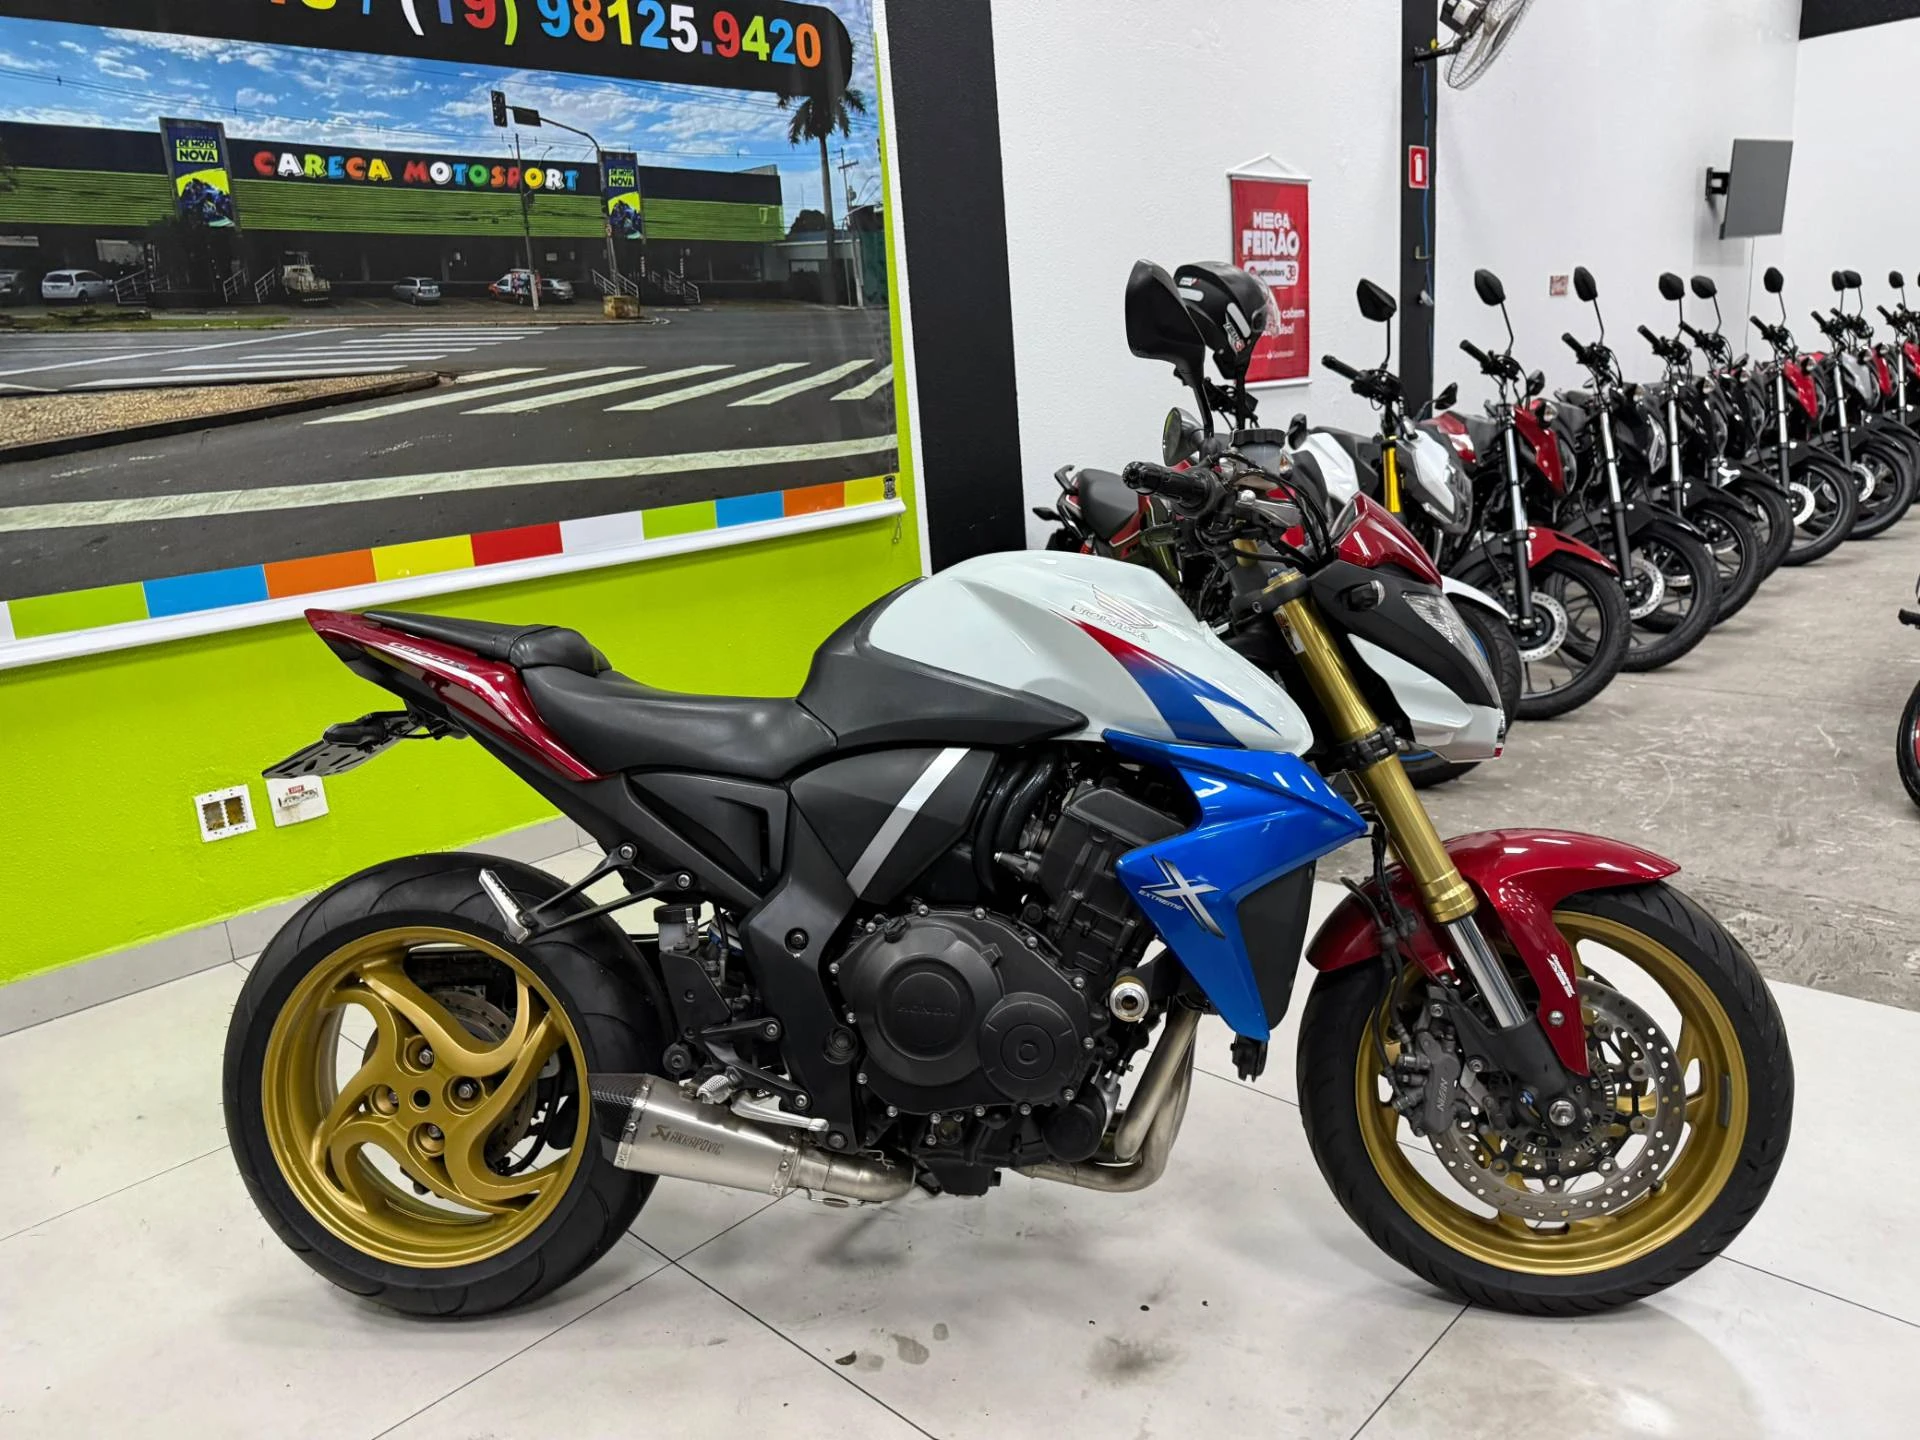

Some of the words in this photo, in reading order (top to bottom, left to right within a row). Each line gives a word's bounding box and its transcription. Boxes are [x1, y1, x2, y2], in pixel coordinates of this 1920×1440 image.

[536, 0, 822, 68] 98125.9420
[179, 149, 216, 161] NOVA
[253, 151, 393, 182] CARECA
[403, 159, 578, 191] MOTOSPORT
[1253, 211, 1291, 230] MEGA
[1242, 228, 1300, 257] FEIRÃO
[1137, 888, 1185, 912] EXTREME
